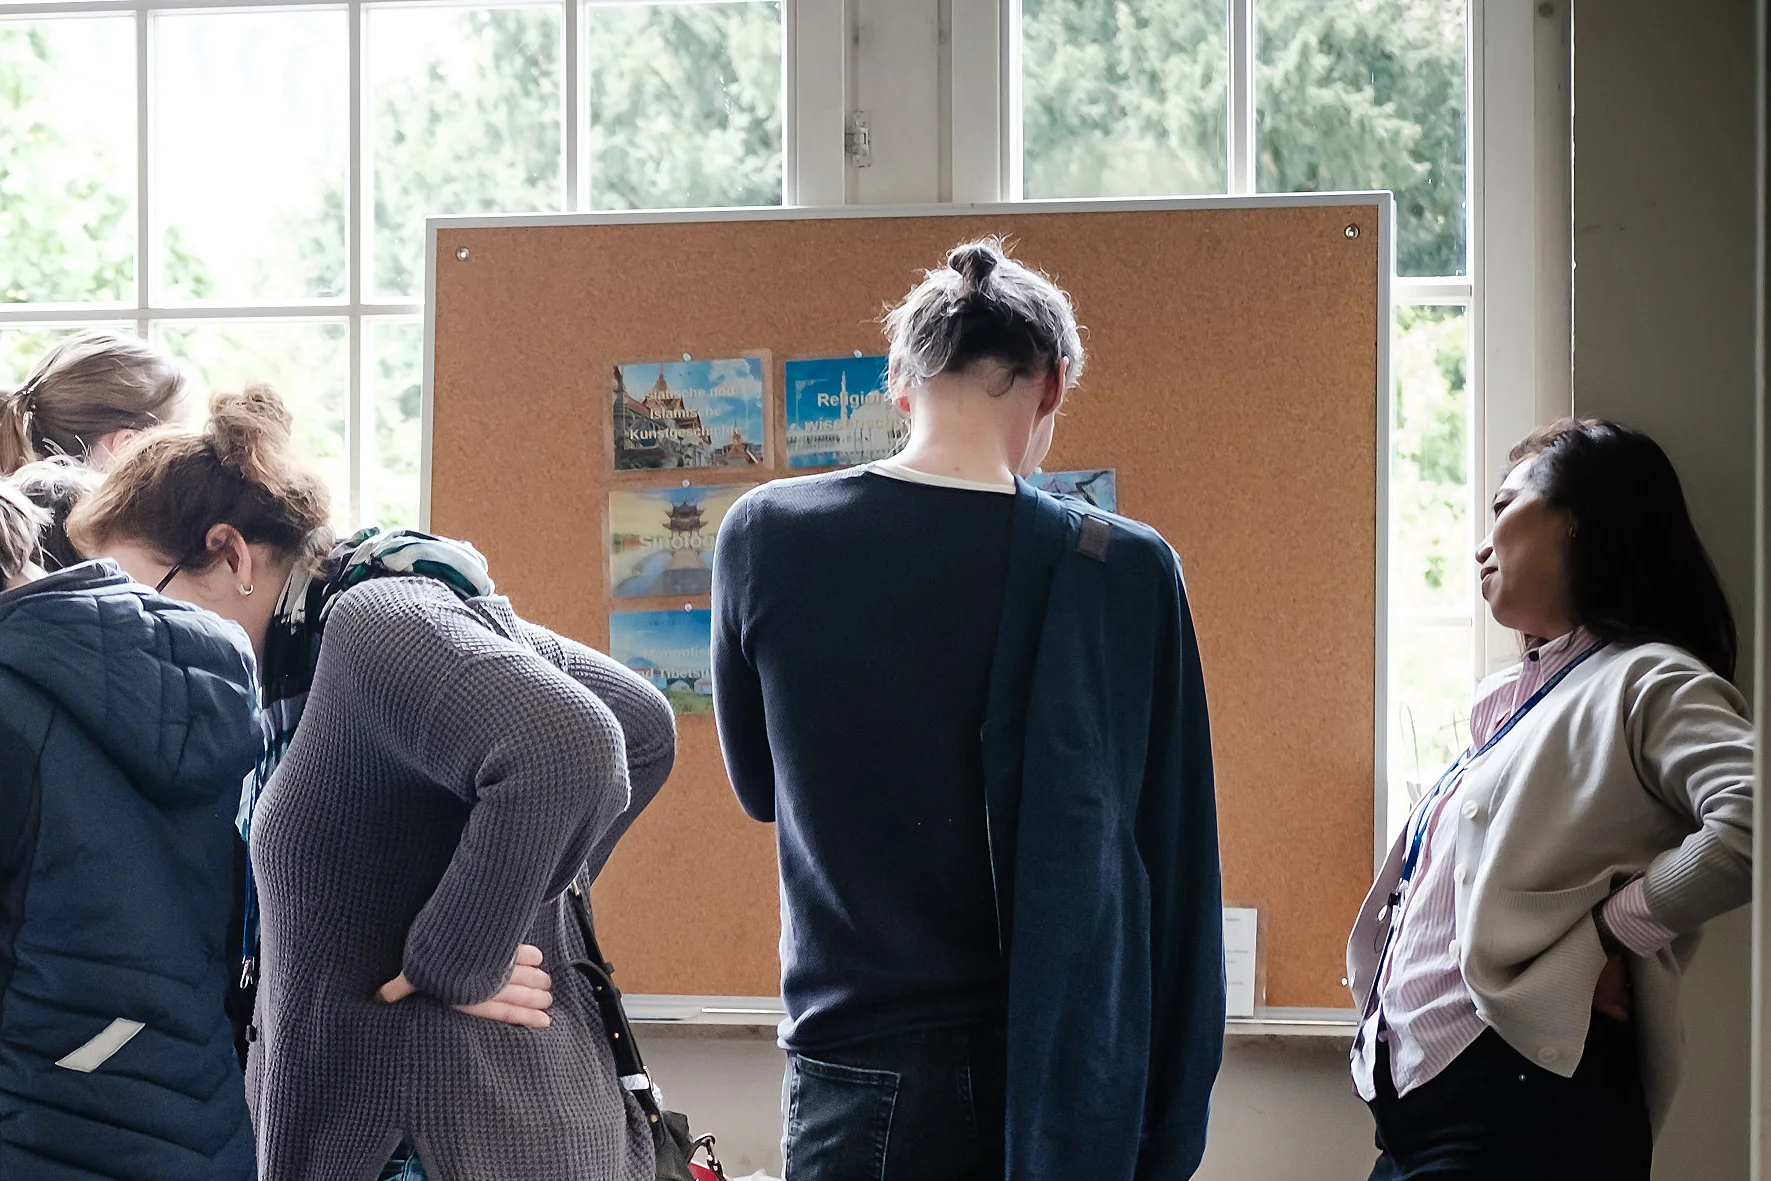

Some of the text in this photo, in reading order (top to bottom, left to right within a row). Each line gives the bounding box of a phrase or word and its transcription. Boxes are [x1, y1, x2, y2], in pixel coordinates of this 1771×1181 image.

[649, 405, 722, 420] Islamische
[629, 425, 744, 441] Kunstgeschichte
[640, 534, 716, 552] Sinolog
[644, 647, 710, 661] Mongolie
[660, 666, 710, 678] Tibetst
